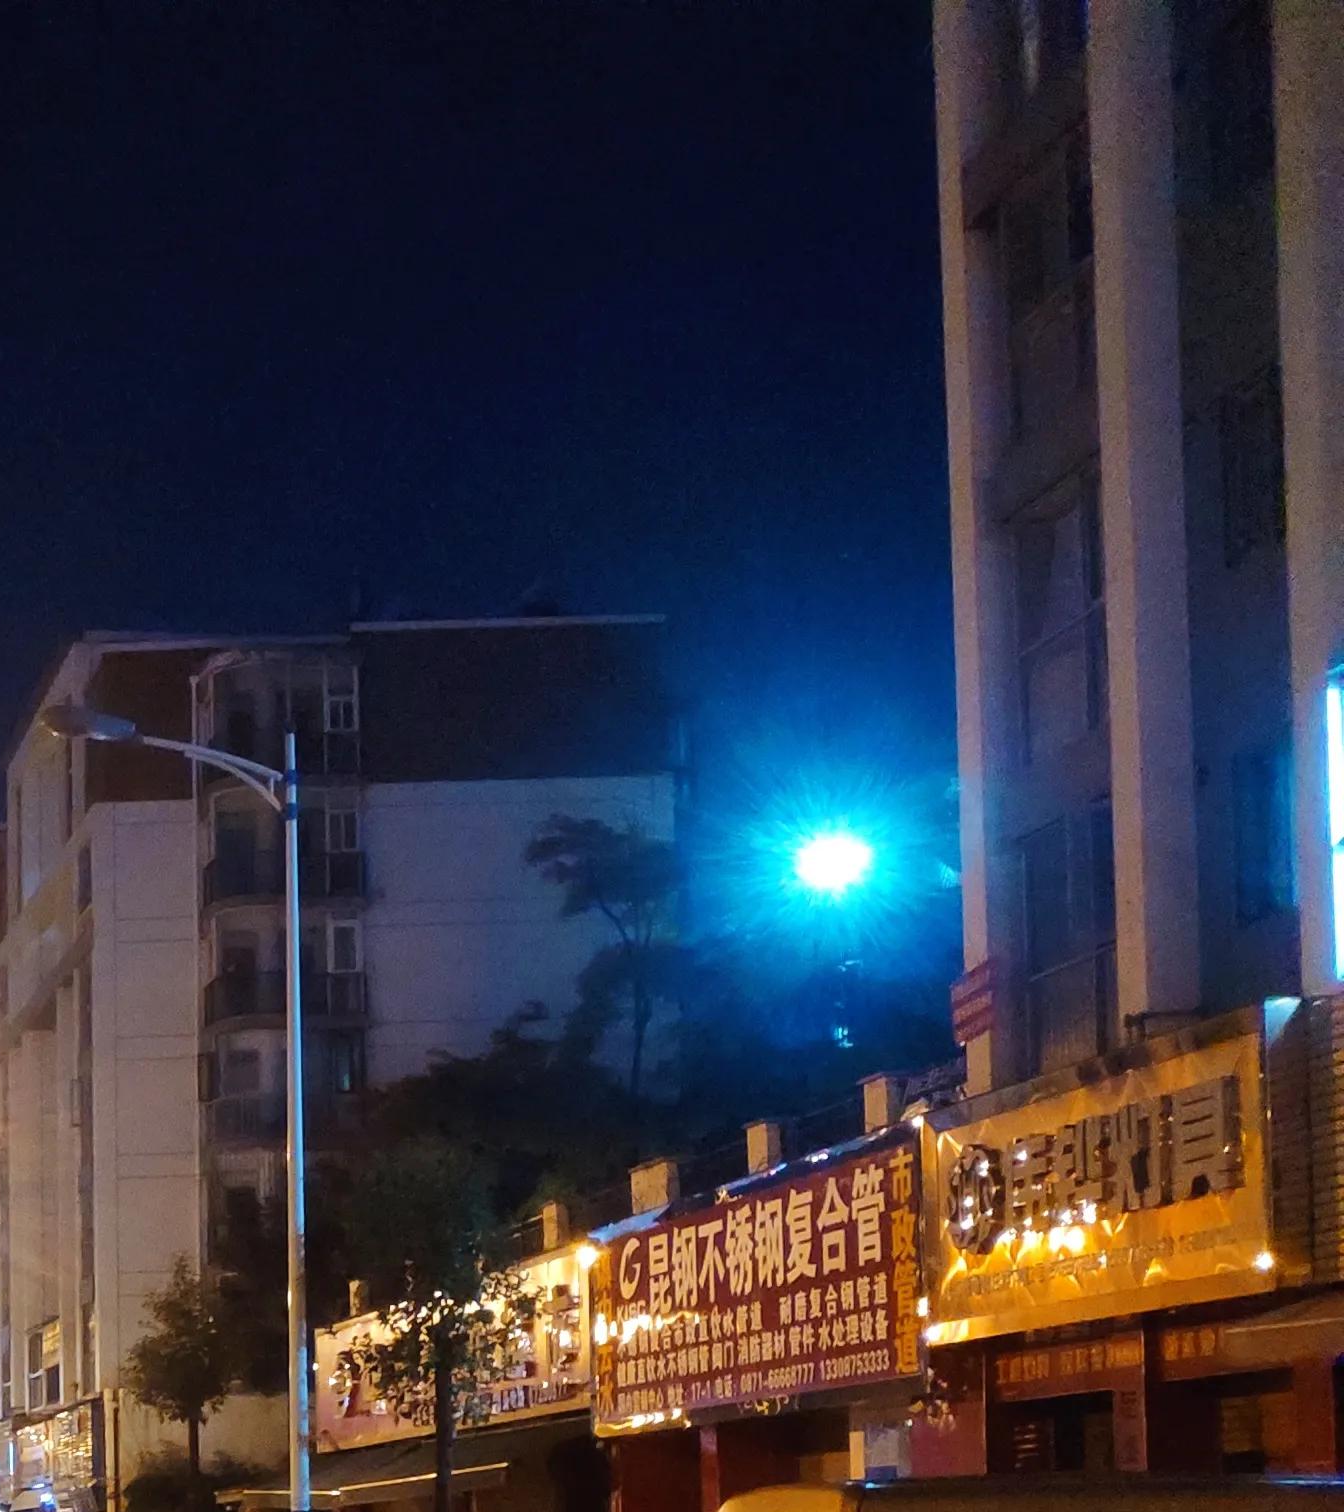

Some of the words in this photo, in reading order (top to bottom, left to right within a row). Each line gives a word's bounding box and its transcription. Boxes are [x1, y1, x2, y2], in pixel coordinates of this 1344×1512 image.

[648, 1163, 885, 1315] 昆钢不锈钢复合管
[890, 1146, 919, 1374] 市政管道
